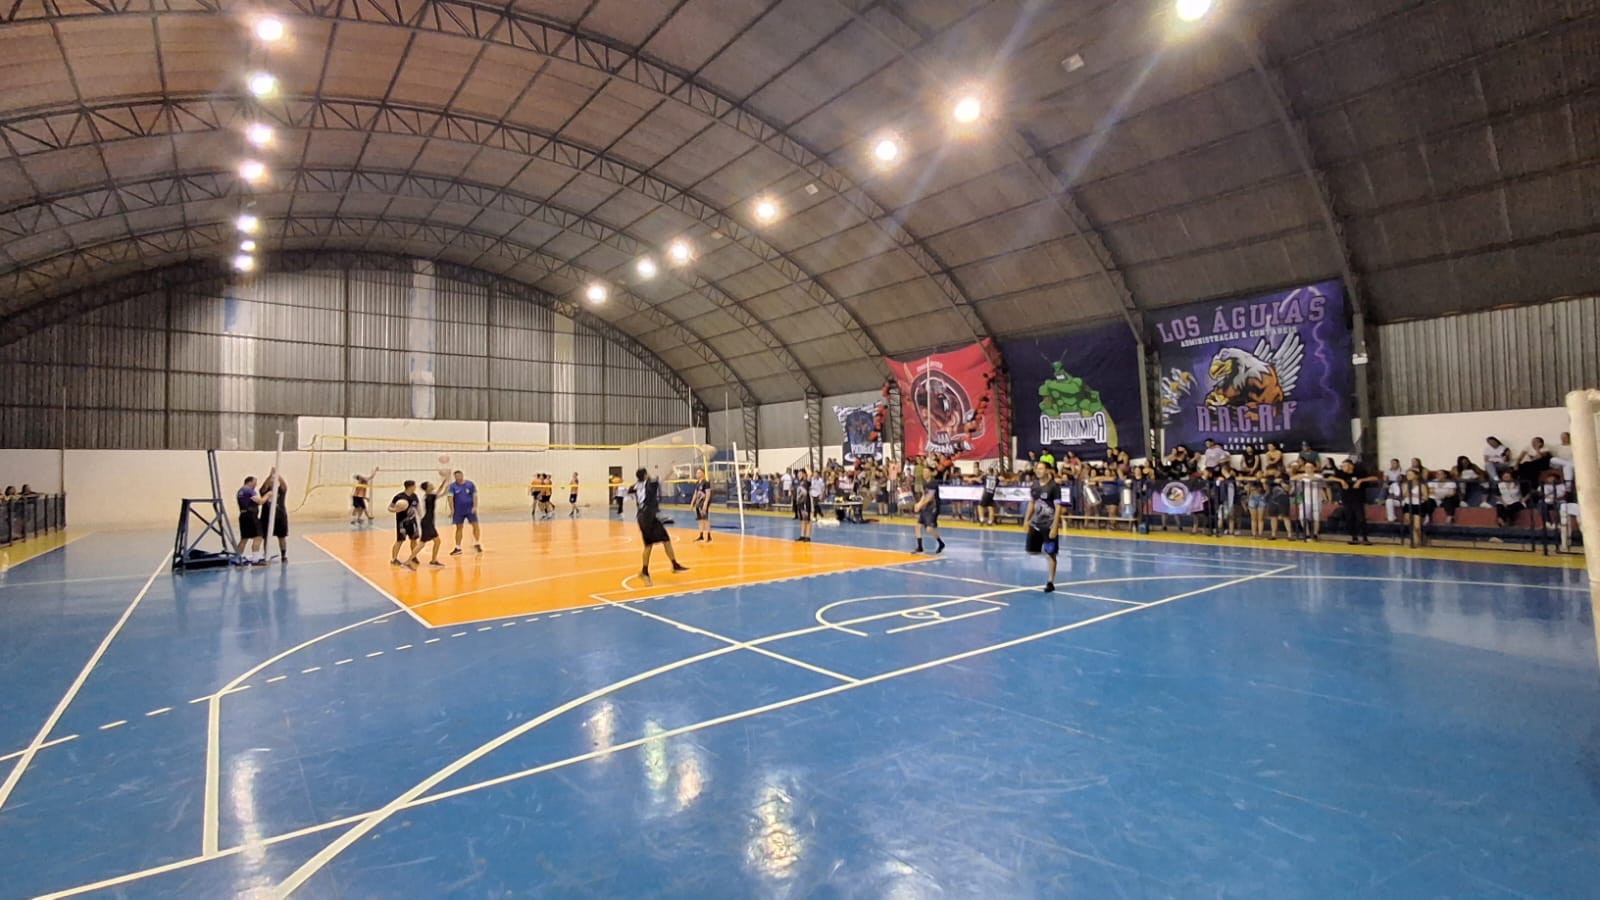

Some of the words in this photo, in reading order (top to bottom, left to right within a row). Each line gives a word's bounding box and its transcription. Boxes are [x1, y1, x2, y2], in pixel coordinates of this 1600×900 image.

[1156, 315, 1200, 343] LOS
[1212, 296, 1326, 333] ÁGUIAS
[1180, 332, 1239, 348] ADMINISTRAÇÃO
